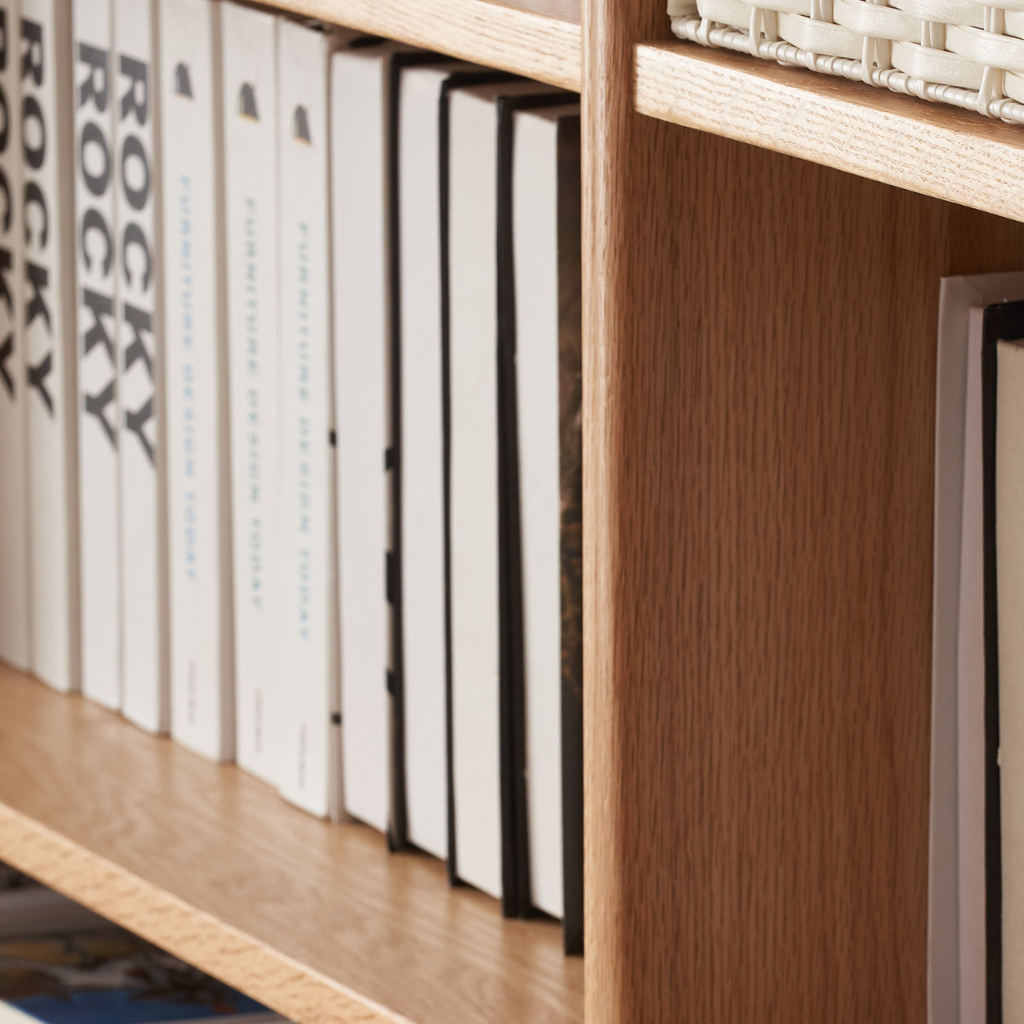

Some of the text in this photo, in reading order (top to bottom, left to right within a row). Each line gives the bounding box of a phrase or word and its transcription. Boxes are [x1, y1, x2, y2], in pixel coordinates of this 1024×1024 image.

[20, 17, 55, 420] ROCKY
[78, 40, 119, 454] ROCKY
[118, 53, 157, 469] ROCKY
